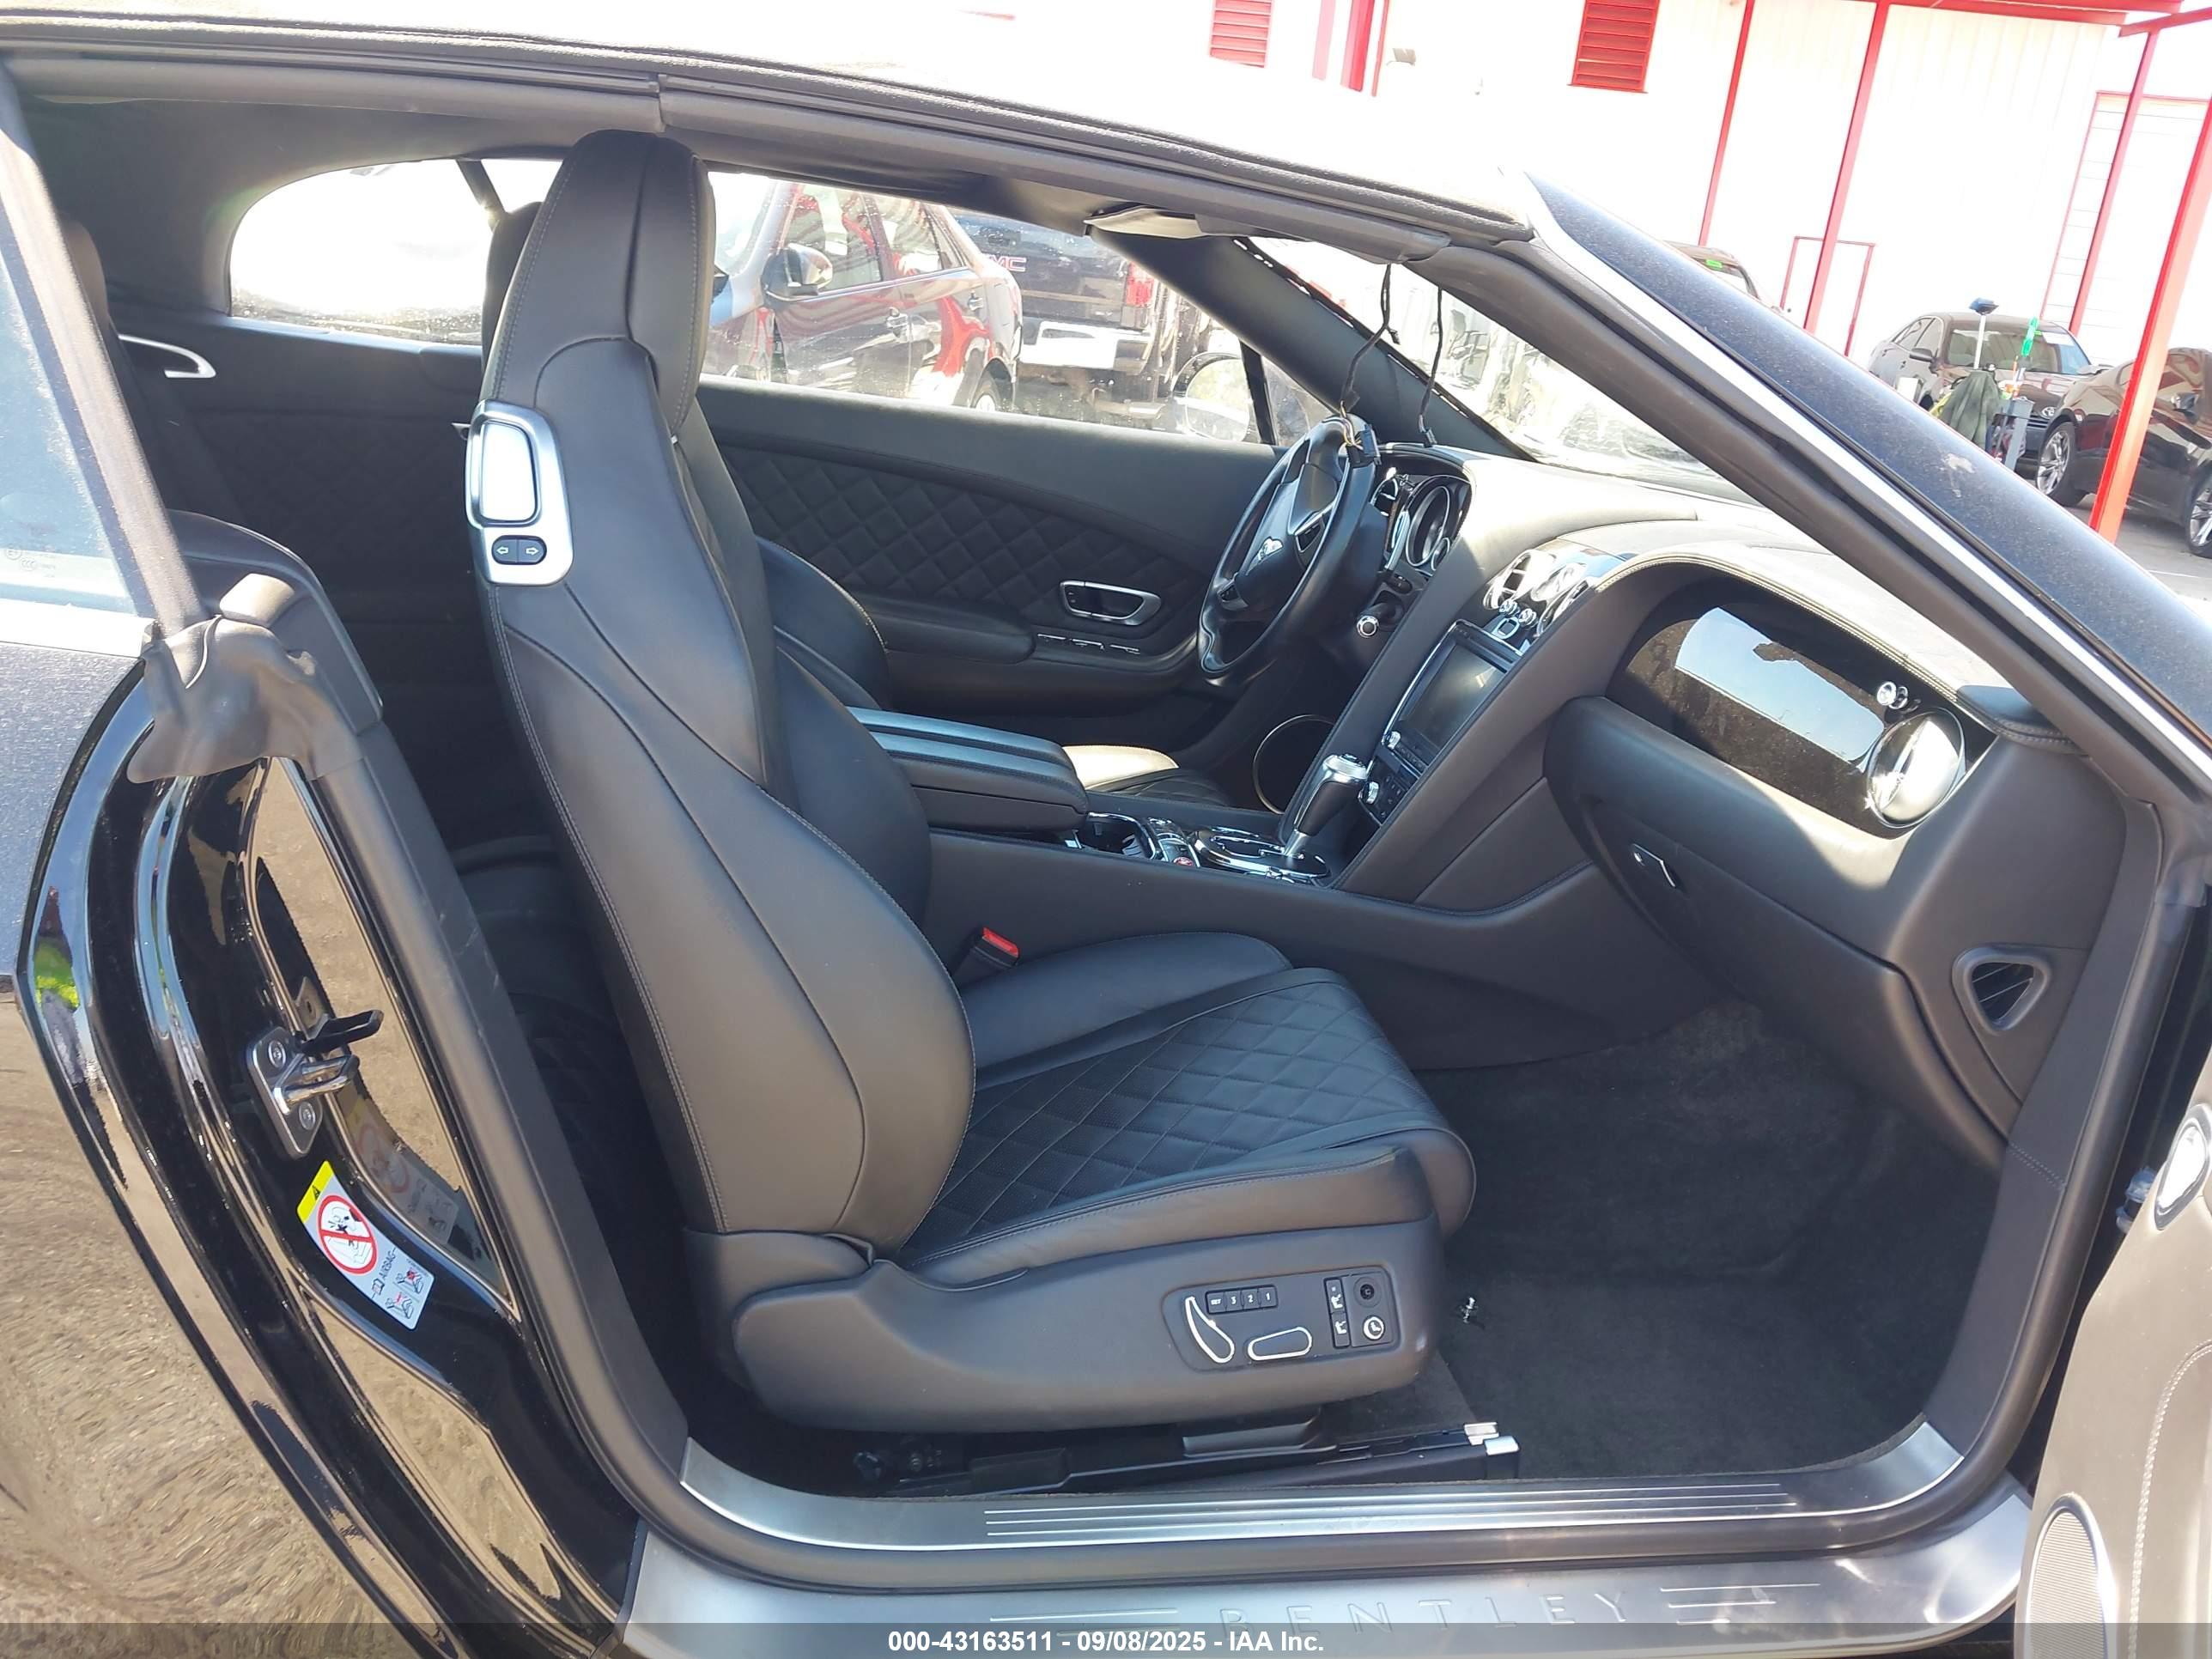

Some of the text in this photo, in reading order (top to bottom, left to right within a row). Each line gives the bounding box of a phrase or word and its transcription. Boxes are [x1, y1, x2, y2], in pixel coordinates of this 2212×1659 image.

[378, 1249, 396, 1280] AIRBAG
[1231, 1296, 1237, 1304] 3
[1248, 1294, 1254, 1303] 2
[1218, 1590, 1627, 1640] BENTLEY
